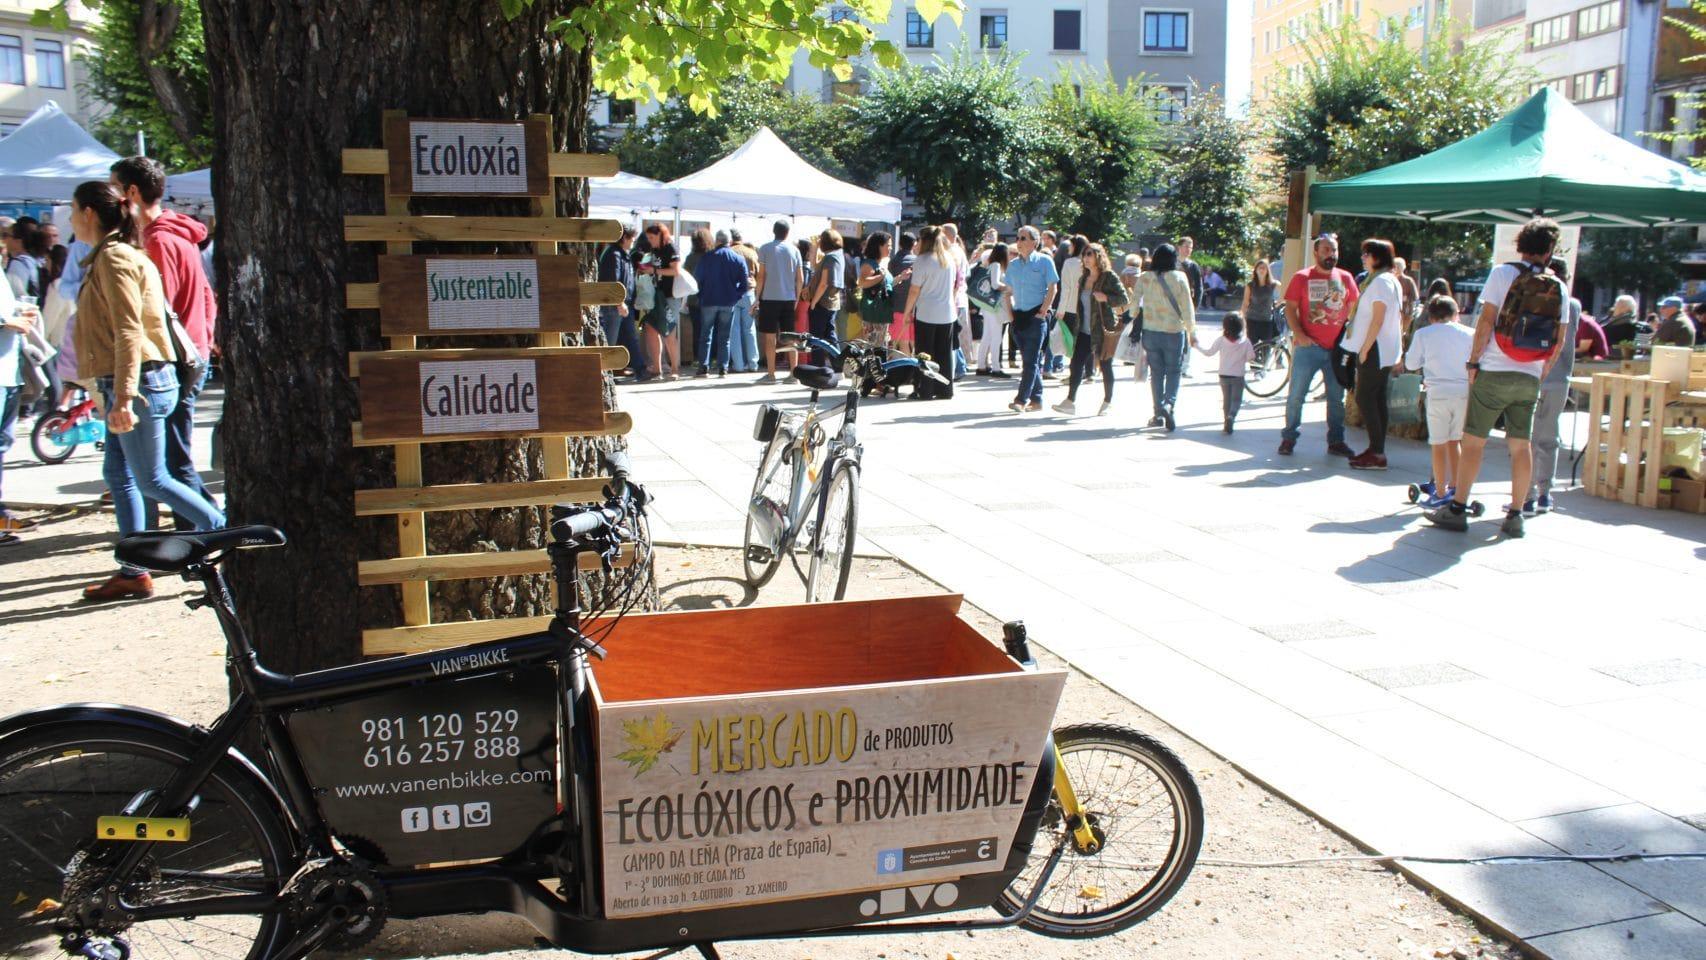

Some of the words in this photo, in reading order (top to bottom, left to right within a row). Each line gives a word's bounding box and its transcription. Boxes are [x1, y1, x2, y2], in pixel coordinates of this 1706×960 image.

[415, 135, 520, 176] Ecoloxía
[430, 272, 532, 302] Sustentable
[422, 372, 535, 417] Calidade
[361, 717, 405, 743] 981
[417, 713, 462, 738] 120
[474, 709, 519, 734] 529
[690, 706, 858, 776] MERCADO
[864, 730, 880, 751] de
[885, 722, 954, 750] PRODUTOS
[363, 743, 412, 768] 616
[418, 740, 465, 764] 257
[473, 736, 521, 759] 888
[335, 769, 552, 798] www.vanenbikke.com
[618, 780, 796, 845] ECOLÓXICOS
[808, 792, 824, 826] e
[836, 761, 1026, 824] PROXIMIDADE
[623, 850, 665, 873] CAMPO
[670, 850, 686, 869] DA
[690, 843, 720, 867] LEÑA
[724, 843, 764, 867] (Praza
[768, 840, 783, 858] de
[786, 835, 832, 859] España)
[613, 896, 639, 909] Aberto
[641, 895, 650, 906] de
[653, 896, 660, 905] 11
[700, 887, 733, 901] OUTUBRO
[745, 885, 756, 896] 22
[757, 881, 788, 894] XANEIRO
[652, 872, 691, 889] DOMINGO
[693, 871, 704, 884] DE
[706, 869, 727, 883] CADA
[730, 867, 746, 880] MES
